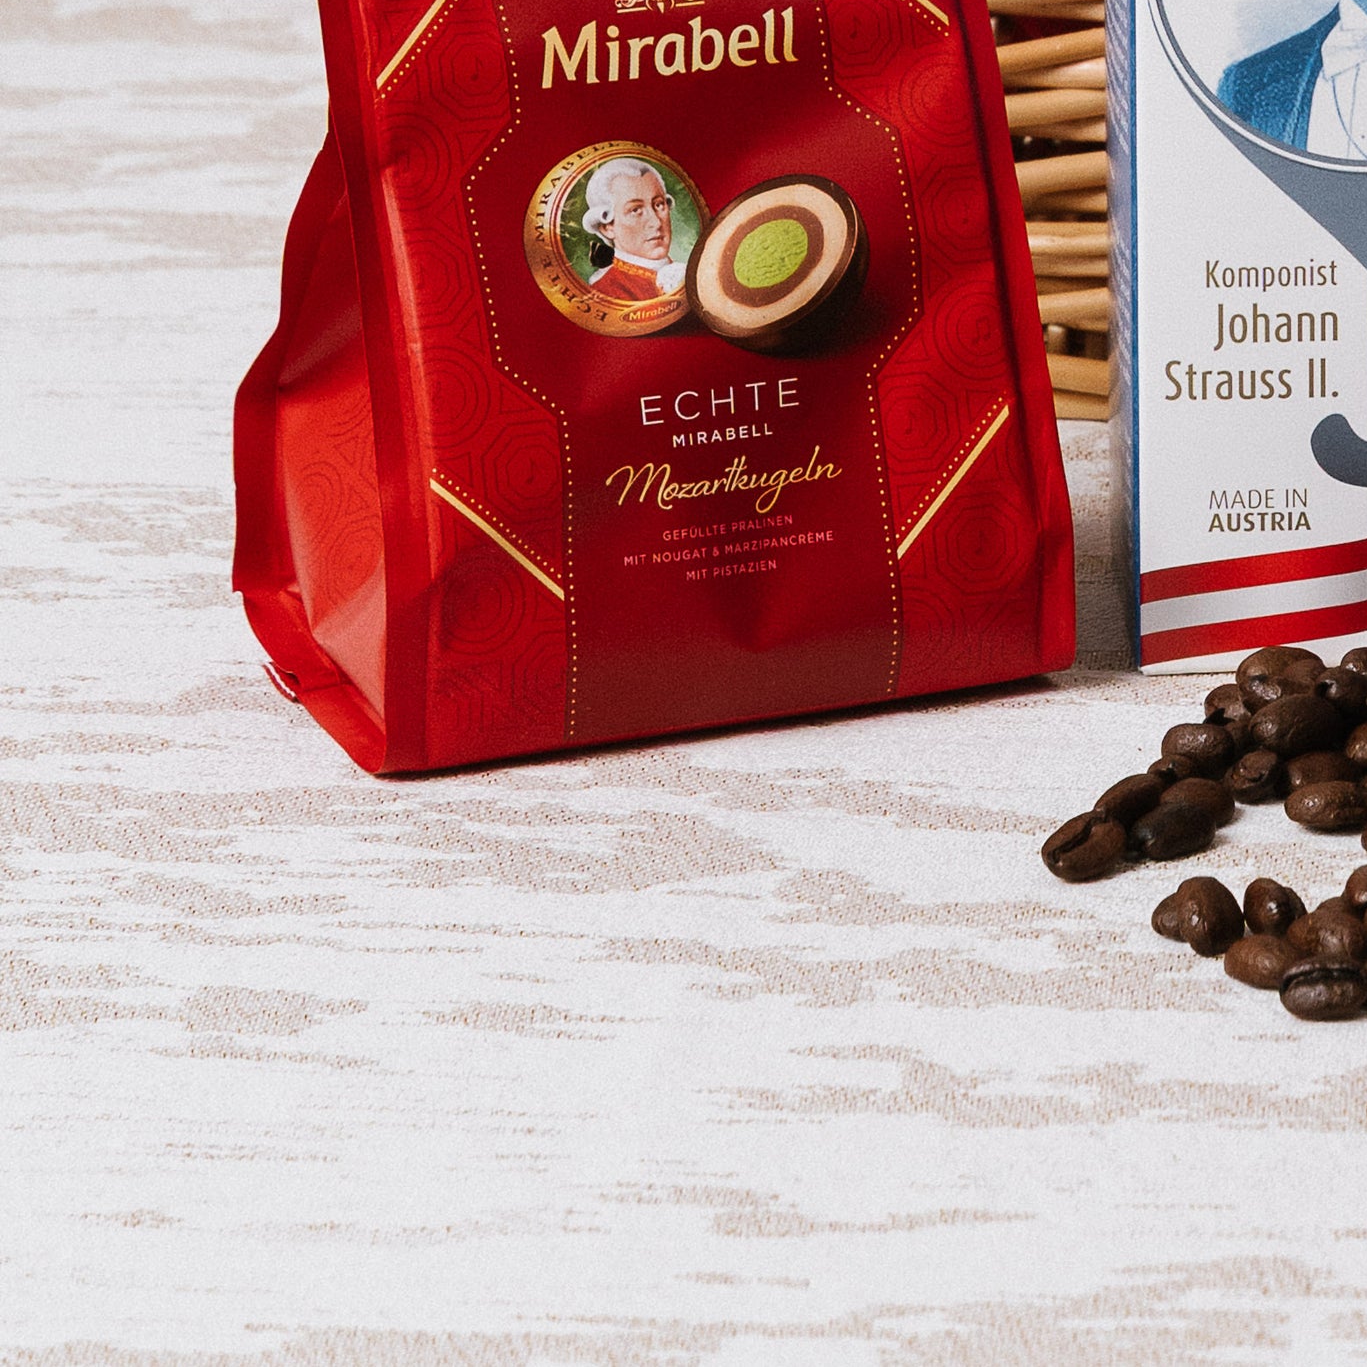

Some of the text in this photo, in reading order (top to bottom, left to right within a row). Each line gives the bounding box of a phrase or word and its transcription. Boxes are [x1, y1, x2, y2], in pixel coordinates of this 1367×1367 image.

[541, 6, 799, 89] Mirabell
[1206, 259, 1338, 292] Komponist
[1213, 303, 1338, 351] Johann
[1165, 360, 1292, 401] Strauss
[640, 377, 799, 425] ECHTE
[672, 423, 773, 448] MIRABELL
[605, 445, 842, 514] Mozartkugeln
[1209, 488, 1308, 510] MADE IN
[662, 515, 794, 541] GEFÜLLTE PRALINEN
[1208, 511, 1312, 533] AUSTRIA
[623, 554, 647, 567] MIT
[652, 547, 707, 564] NOUGAT
[724, 530, 834, 555] MARZIPANCRÈME
[686, 559, 777, 581] MIT PISTAZIEN
